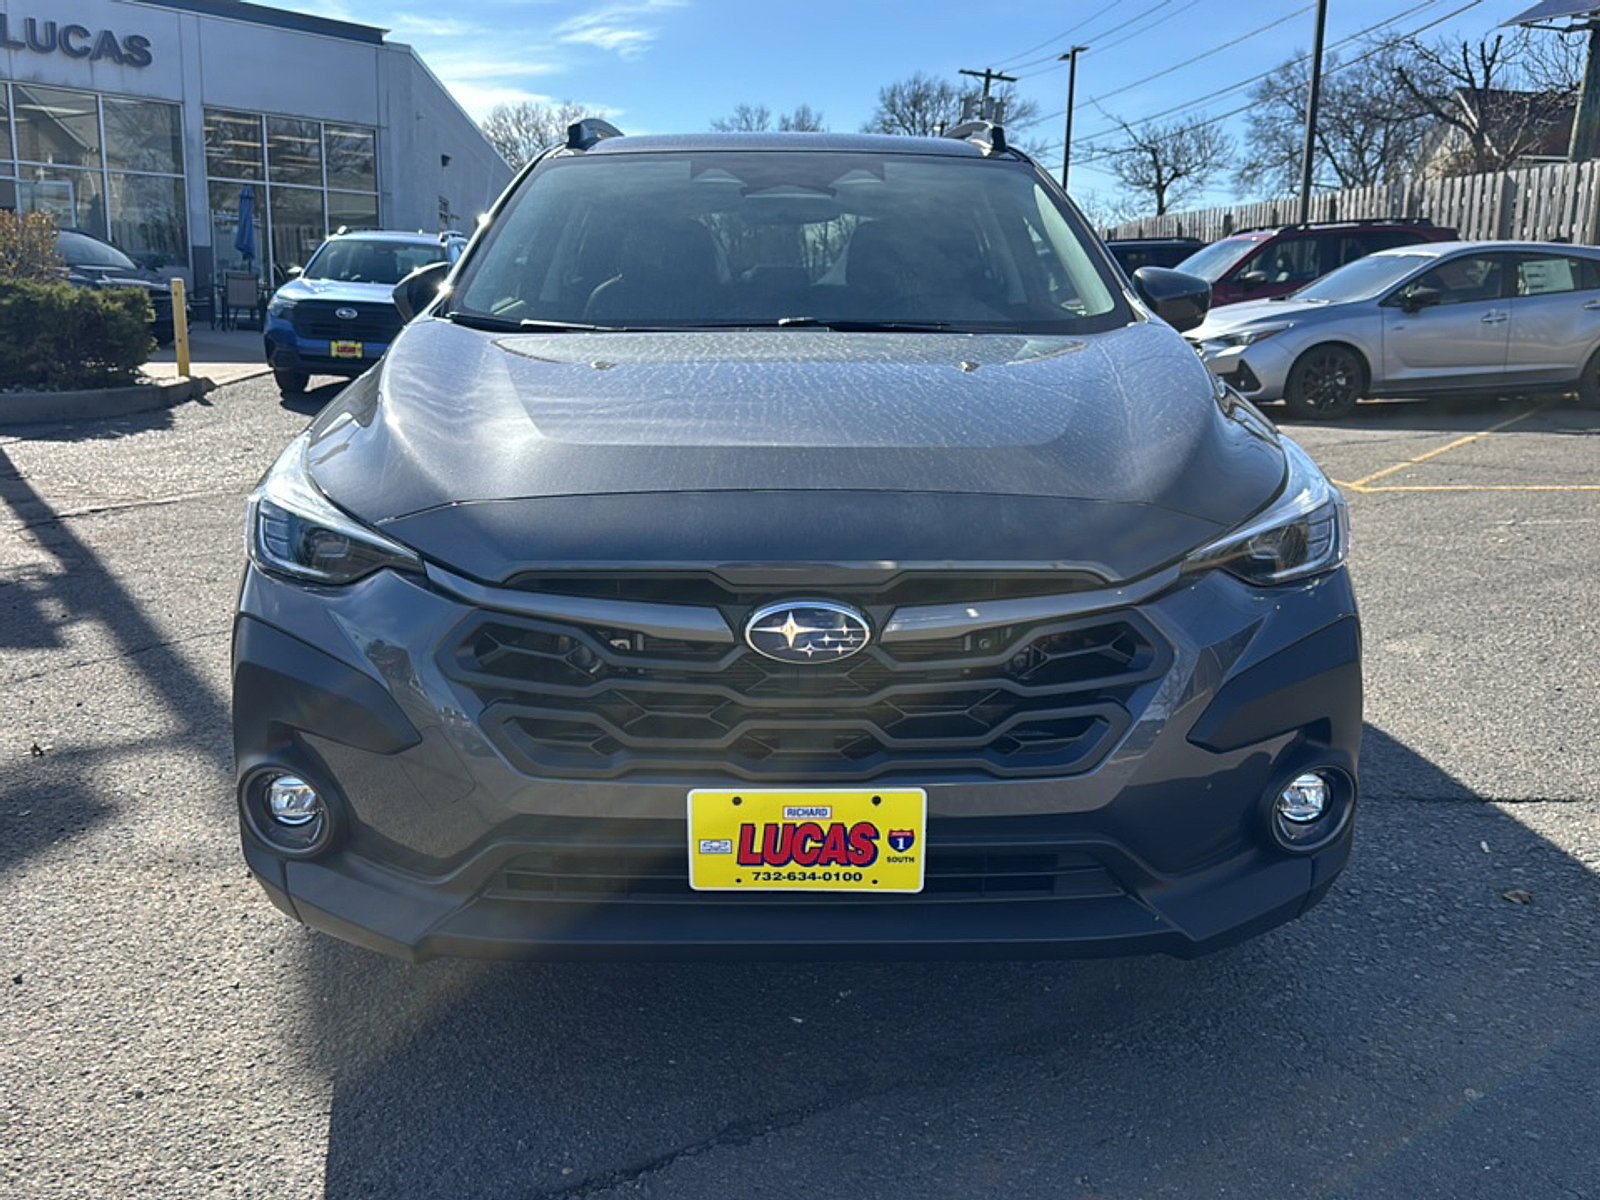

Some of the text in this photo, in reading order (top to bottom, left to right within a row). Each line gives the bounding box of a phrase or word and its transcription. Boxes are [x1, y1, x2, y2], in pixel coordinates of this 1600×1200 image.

[0, 13, 152, 67] LUCAS
[787, 808, 828, 816] RICHARD
[737, 822, 880, 867] LUCAS
[896, 837, 904, 849] 1
[752, 871, 863, 882] 732-634-0100
